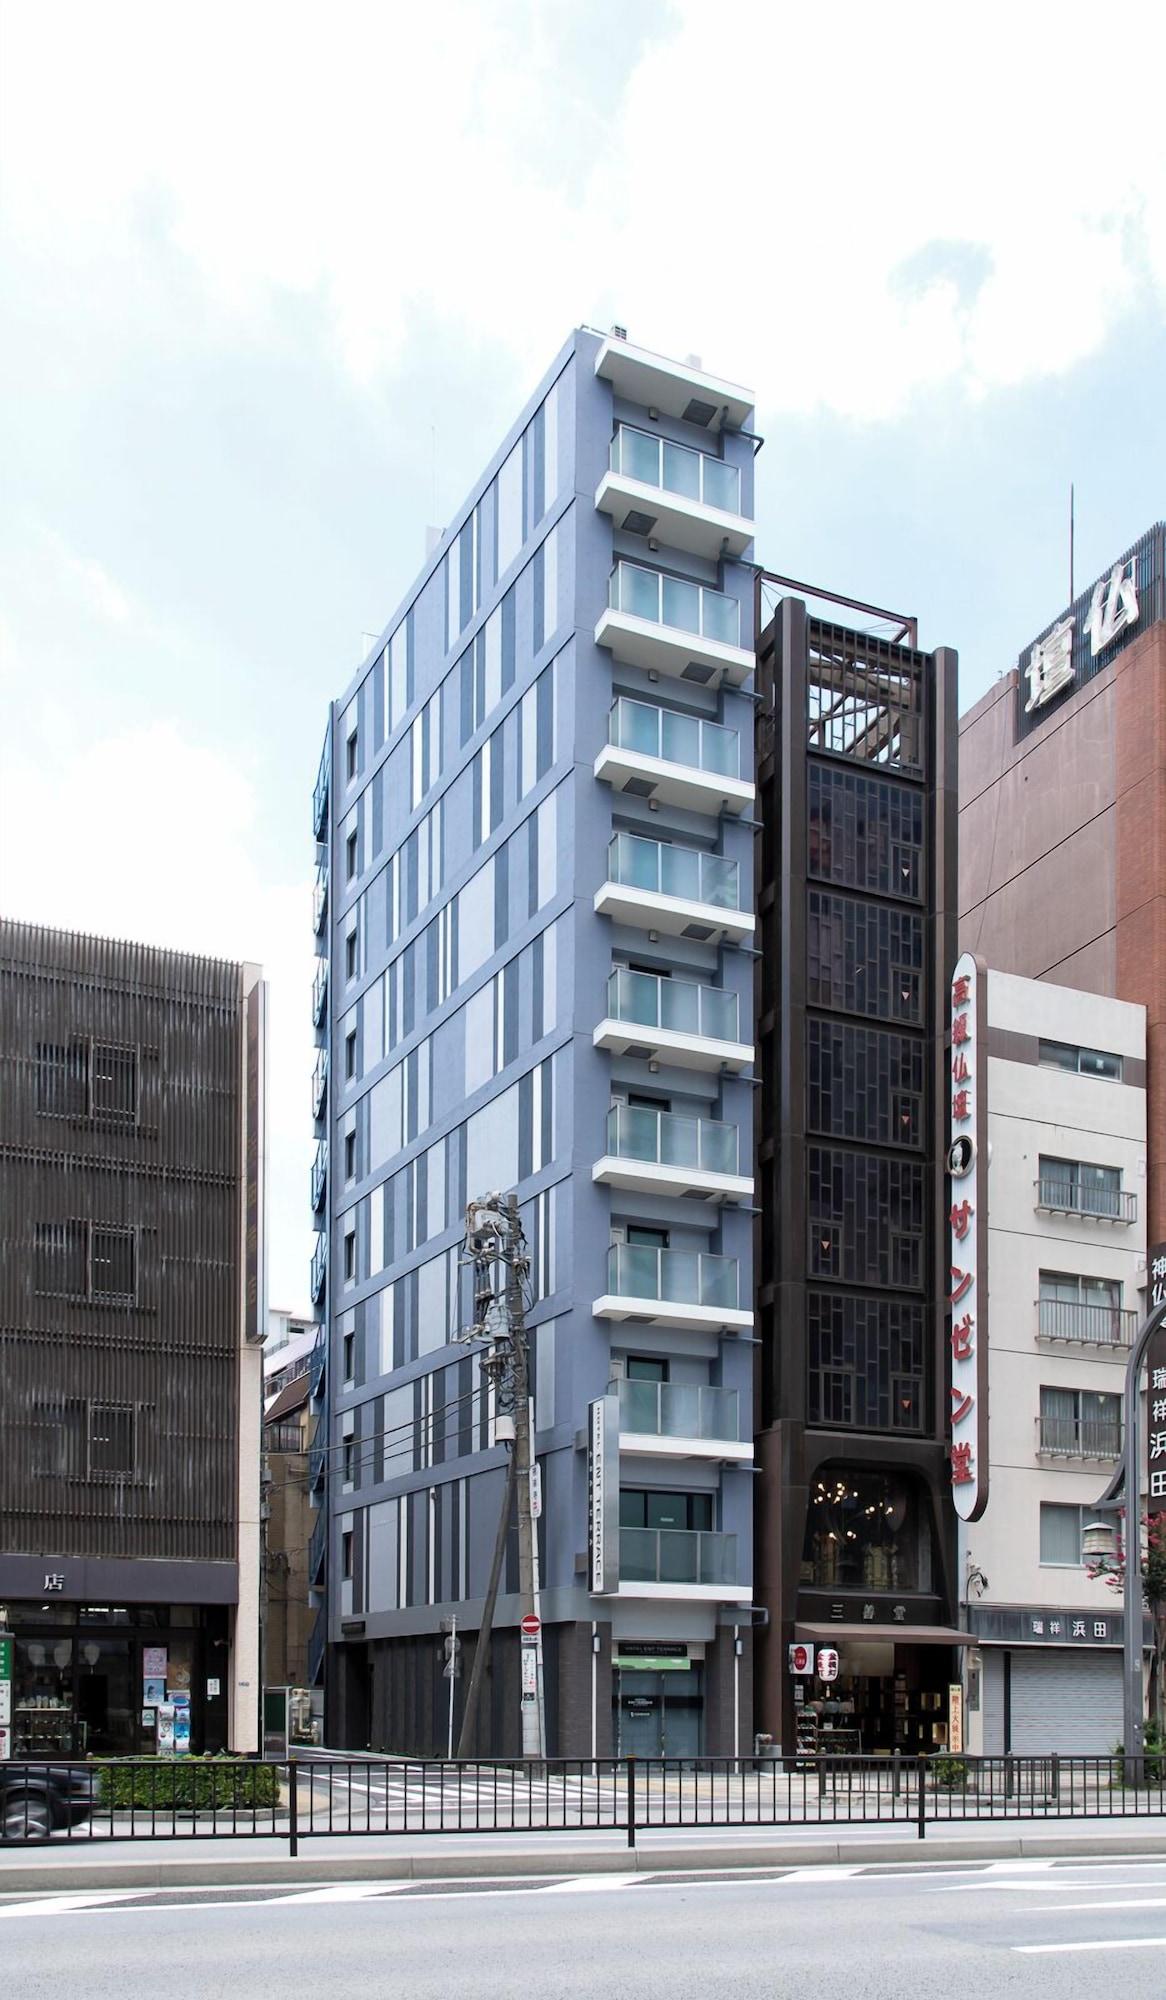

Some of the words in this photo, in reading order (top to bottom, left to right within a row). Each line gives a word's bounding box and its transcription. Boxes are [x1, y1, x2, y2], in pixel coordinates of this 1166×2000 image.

[950, 1200, 975, 1486] サンゼン堂
[44, 1573, 65, 1590] 店
[1032, 1620, 1107, 1638] 瑞祥浜田
